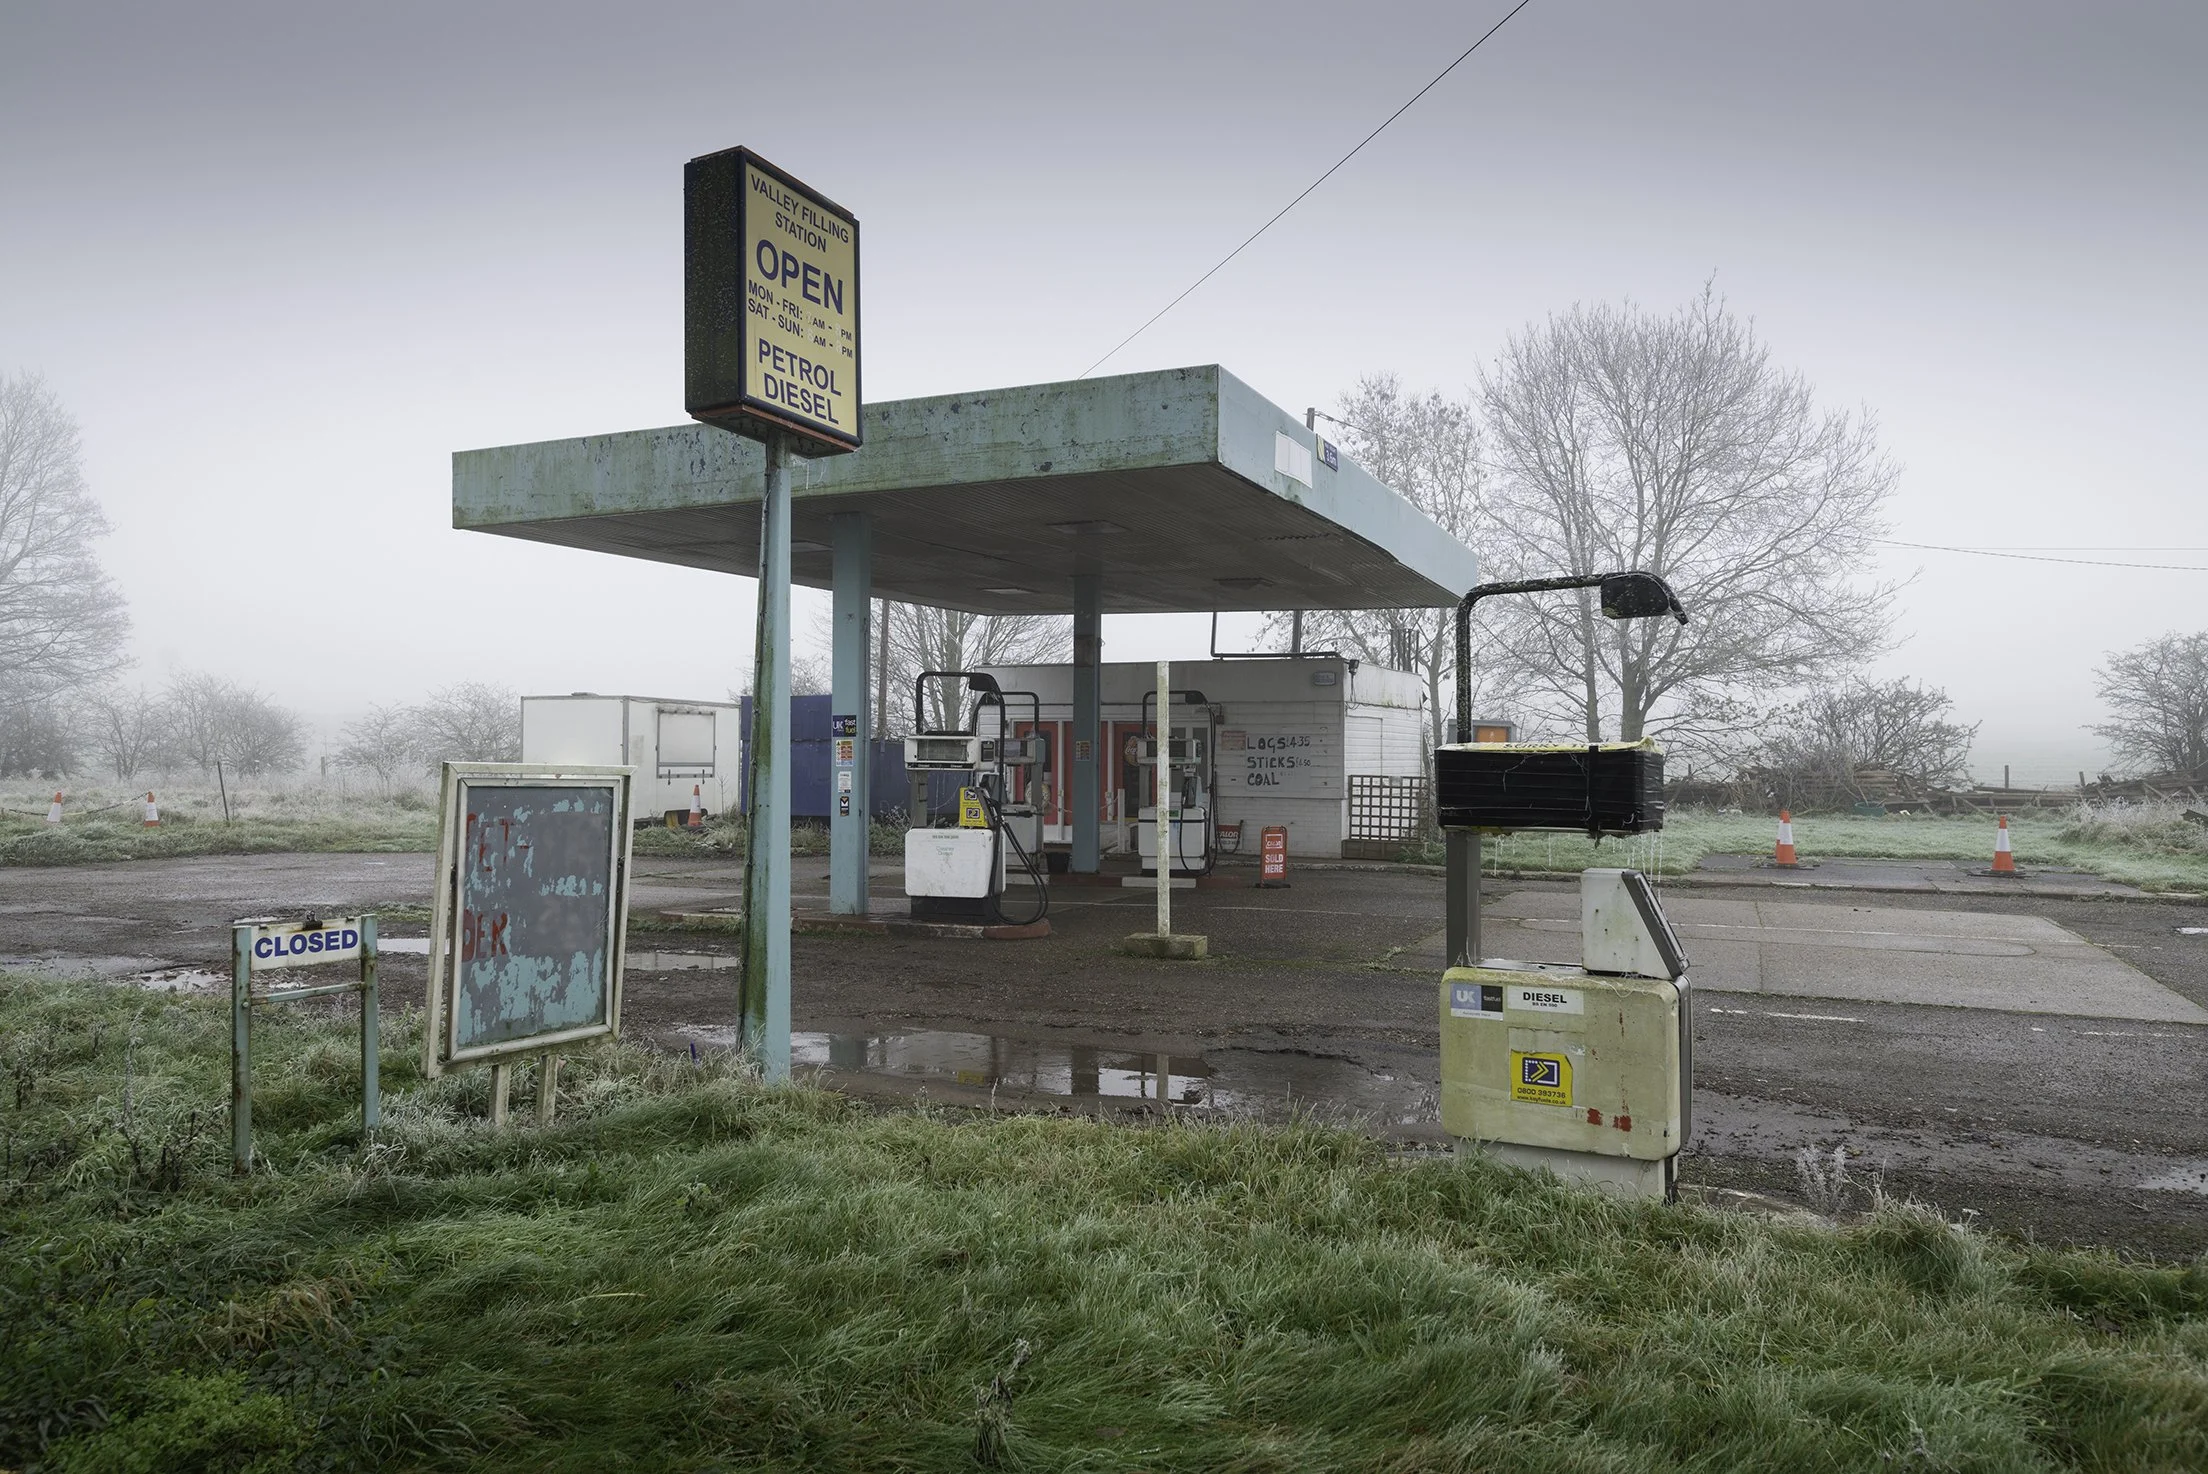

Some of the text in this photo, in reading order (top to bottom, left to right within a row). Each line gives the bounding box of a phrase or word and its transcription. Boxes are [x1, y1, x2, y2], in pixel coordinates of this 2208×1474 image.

[751, 173, 849, 243] VALLEY FILLING
[775, 211, 827, 253] STATION
[756, 239, 843, 316] OPEN
[748, 279, 774, 305] MON
[782, 298, 803, 320] FRI:
[748, 298, 770, 320] SAT
[778, 314, 803, 338] SUN:
[758, 338, 842, 397] PETROL
[763, 373, 839, 424] DIESEL
[1247, 736, 1286, 753] LOGS
[1247, 756, 1295, 769] STICKS
[1247, 771, 1280, 786] COAL
[1217, 831, 1239, 839] ALOR
[1265, 854, 1284, 863] SOLD
[1265, 864, 1284, 874] HERE
[254, 929, 358, 959] CLOSED
[1456, 990, 1476, 1003] UK
[1522, 991, 1568, 1004] DIESEL
[1517, 1087, 1537, 1095] 0800
